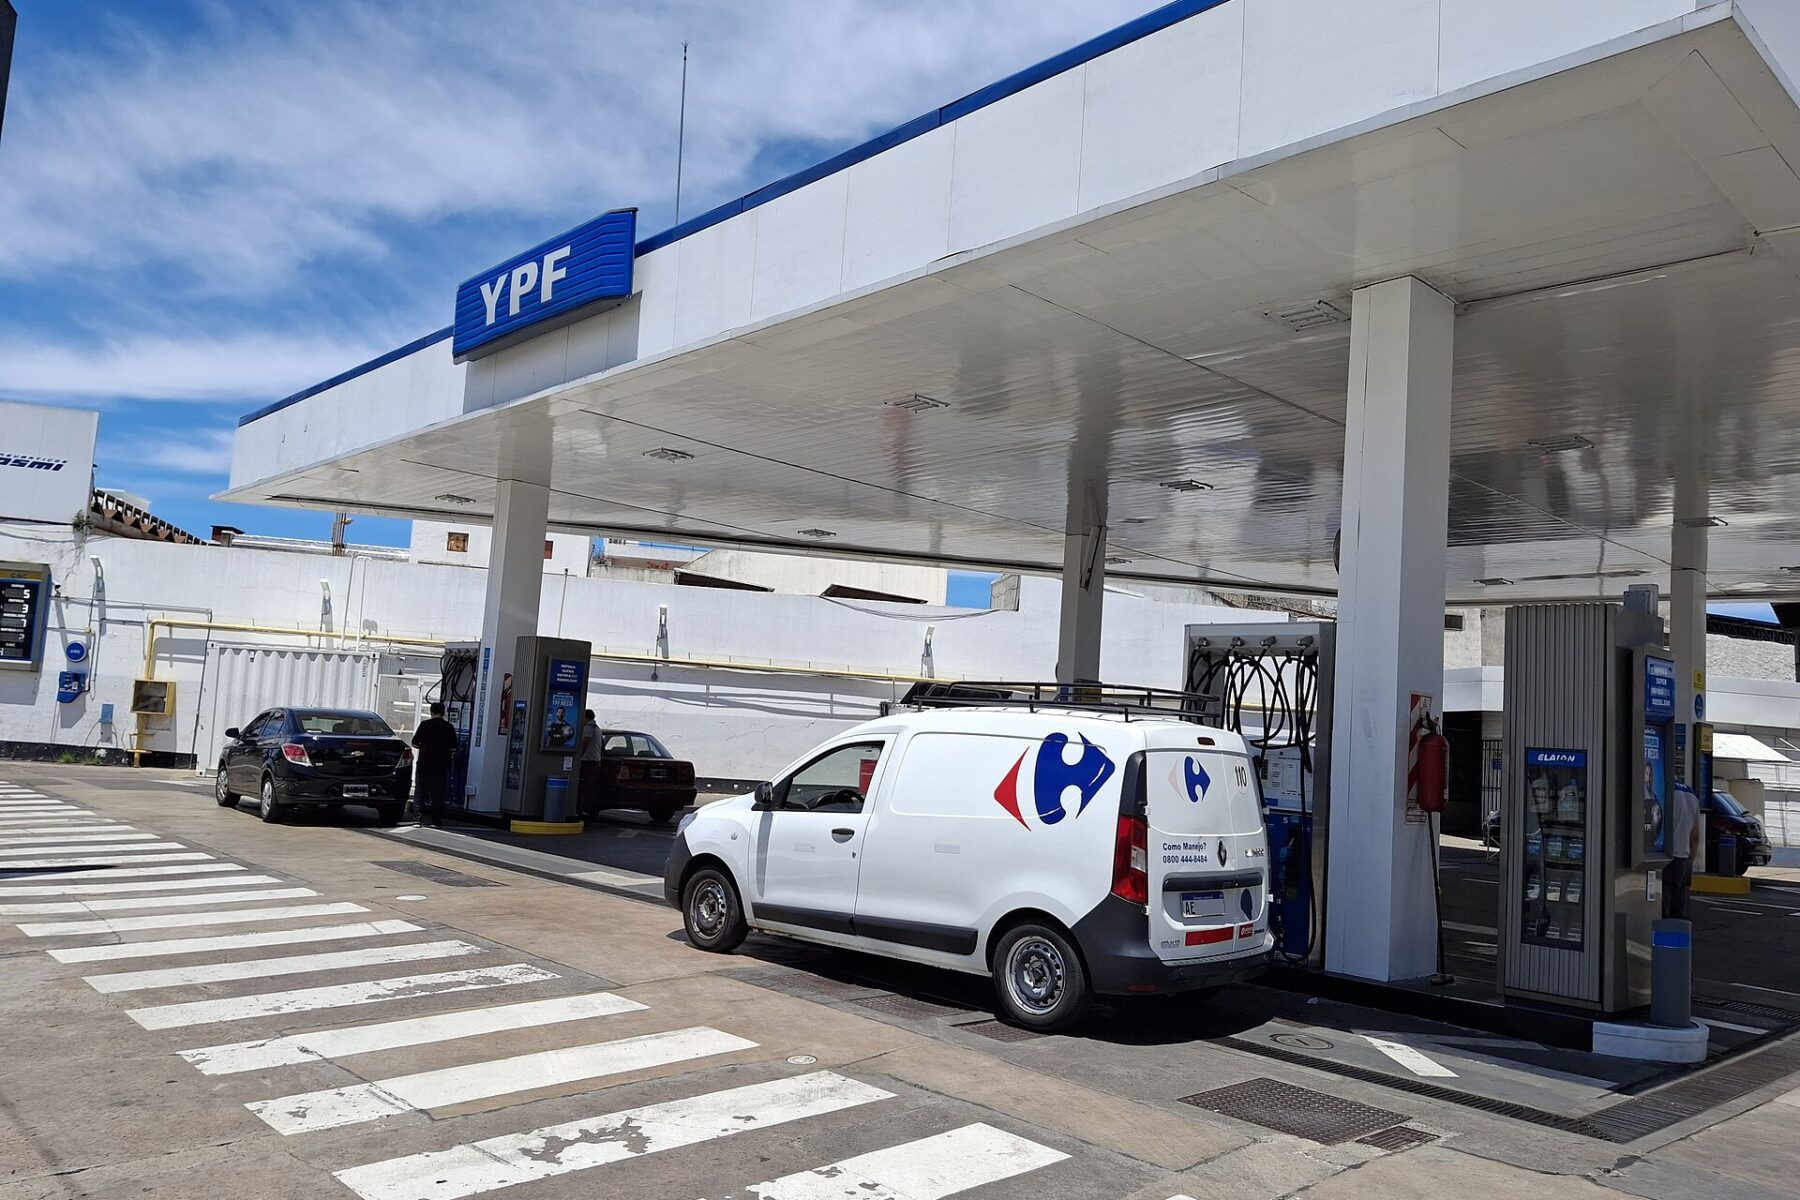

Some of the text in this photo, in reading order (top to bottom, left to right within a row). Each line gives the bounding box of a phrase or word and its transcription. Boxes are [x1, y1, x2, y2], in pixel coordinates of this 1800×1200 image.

[479, 244, 571, 326] YPF
[1234, 765, 1248, 787] 110
[1162, 842, 1207, 852] Como Manejo?
[1162, 855, 1208, 863] 0800 444-8484
[1185, 901, 1196, 916] AE
